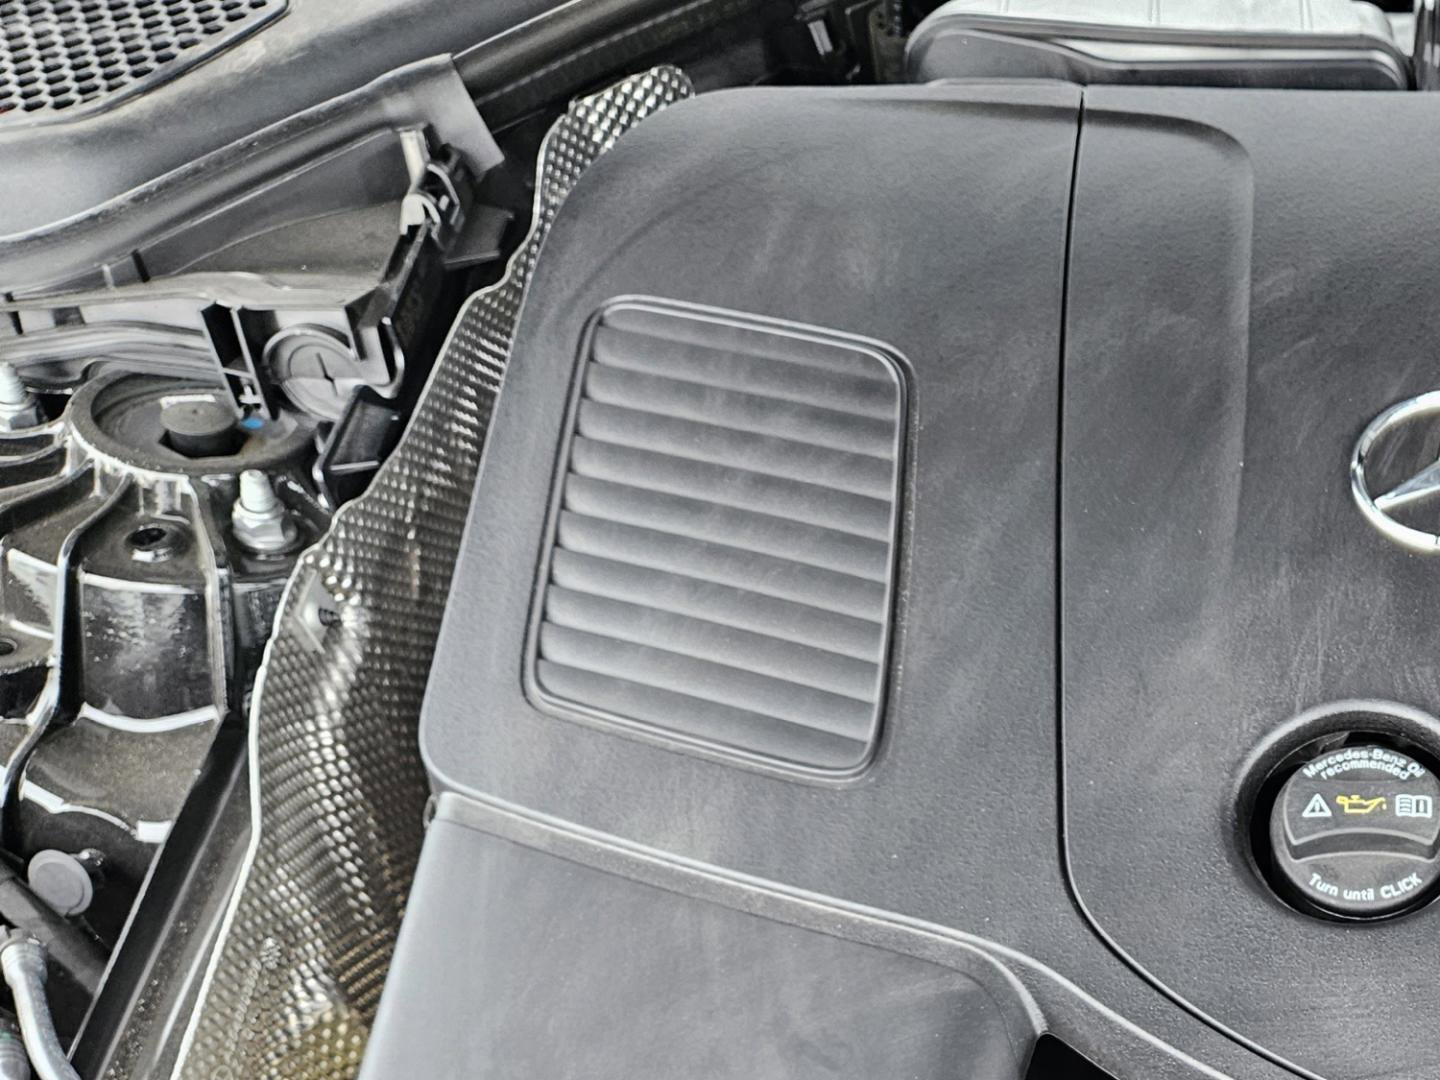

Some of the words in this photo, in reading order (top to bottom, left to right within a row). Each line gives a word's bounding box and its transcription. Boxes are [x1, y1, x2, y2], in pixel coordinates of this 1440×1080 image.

[1302, 748, 1407, 778] Mercedes-Benz
[1320, 759, 1410, 780] recommended
[1309, 872, 1339, 896] Turn
[1343, 887, 1375, 901] until
[1380, 872, 1422, 899] CLICK
